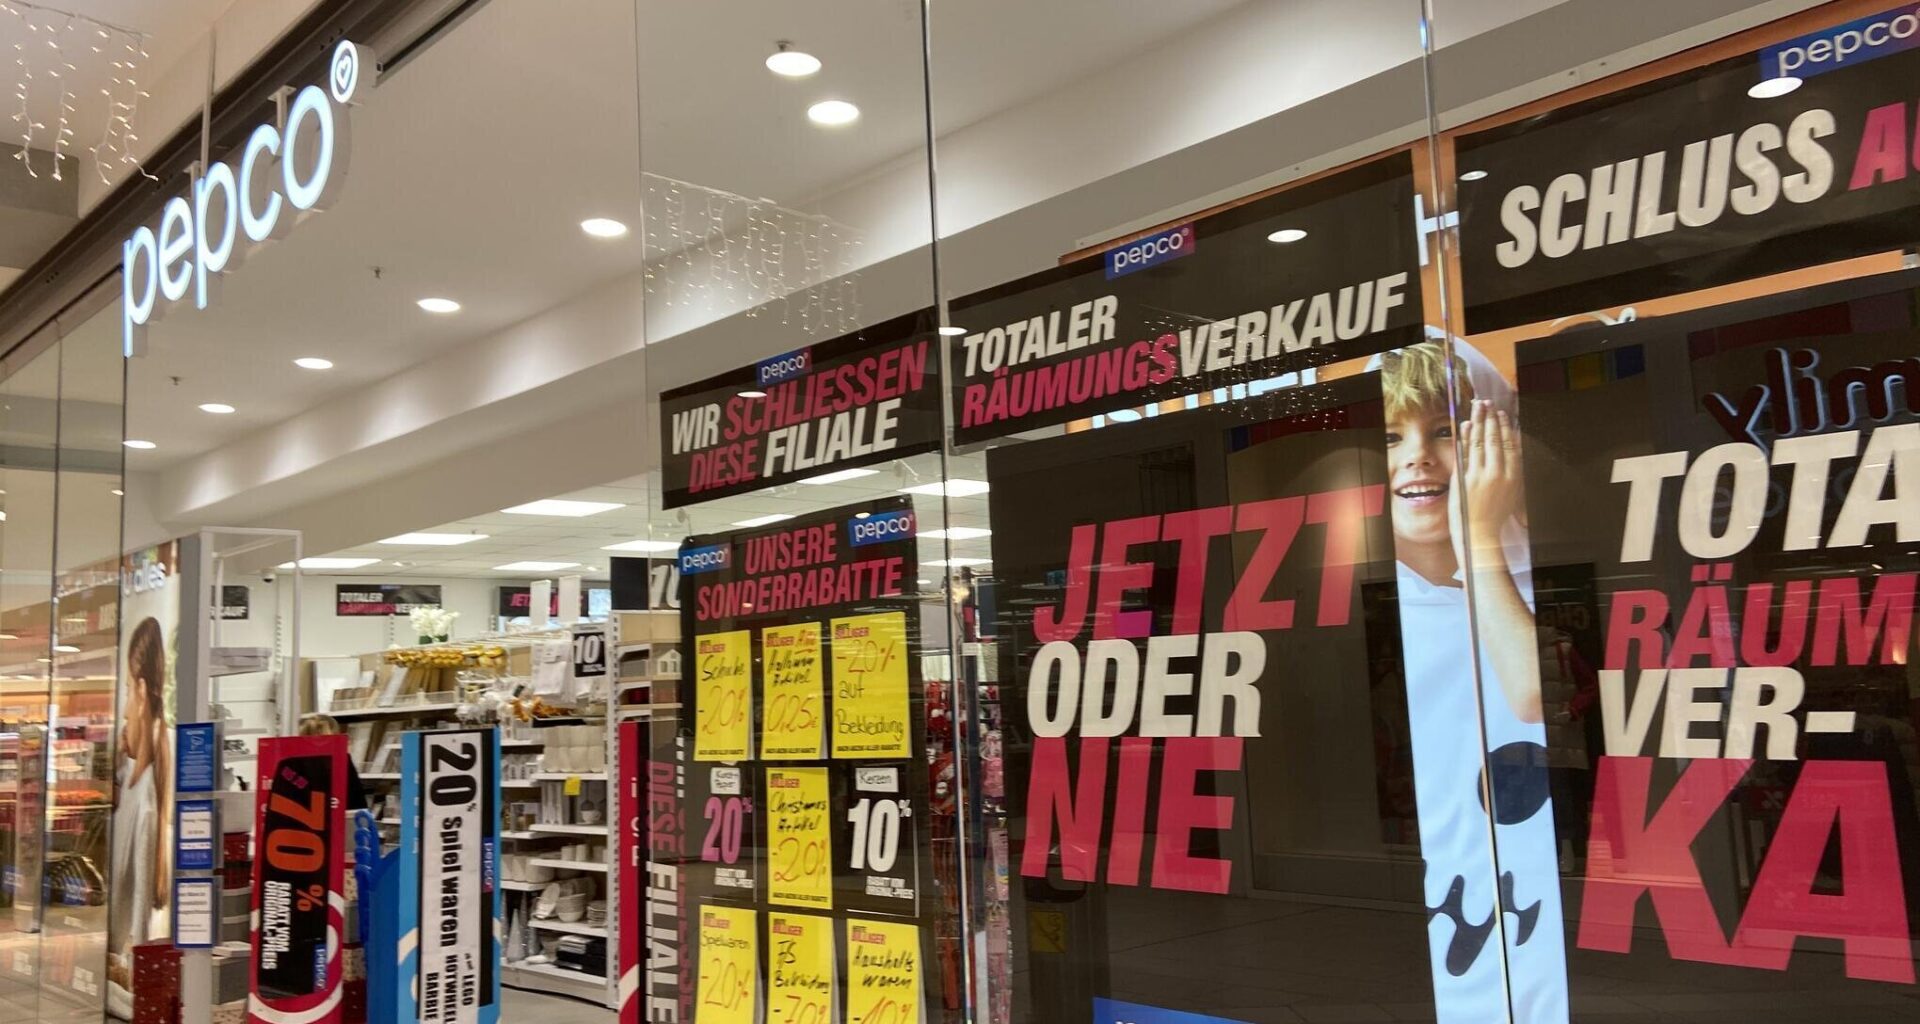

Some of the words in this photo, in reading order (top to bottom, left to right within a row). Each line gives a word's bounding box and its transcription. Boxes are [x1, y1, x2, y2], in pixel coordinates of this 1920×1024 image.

[1779, 12, 1917, 77] pepco
[122, 84, 335, 358] pepco
[1496, 108, 1837, 268] SCHLUSS
[1113, 228, 1187, 272] pepco
[760, 352, 807, 383] pepco
[962, 294, 1119, 378] TOTALER
[671, 402, 722, 455] WIR
[724, 341, 929, 440] SCHLIESSEN
[688, 440, 758, 494] DIESE
[763, 398, 903, 478] FILIALE
[855, 515, 912, 542] pepco
[1610, 422, 1920, 564] TOTA
[683, 548, 729, 571] pepco
[696, 556, 904, 622] SONDERRABATTE
[744, 522, 837, 575] UNSERE
[1033, 484, 1386, 643] JETZT
[1603, 562, 1918, 671] RÄUM
[838, 672, 866, 699] auf
[1027, 630, 1268, 738] ODER
[1598, 666, 1857, 760] VER-
[646, 760, 677, 853] DIESE
[702, 796, 753, 864] 20%
[847, 798, 912, 872] 10%
[1020, 737, 1244, 895] NIE
[277, 881, 292, 924] RABATT
[1577, 755, 1917, 986] KA
[646, 861, 678, 1024] FILIALE
[424, 971, 440, 1021] BARBIE
[461, 974, 476, 1006] LEGO
